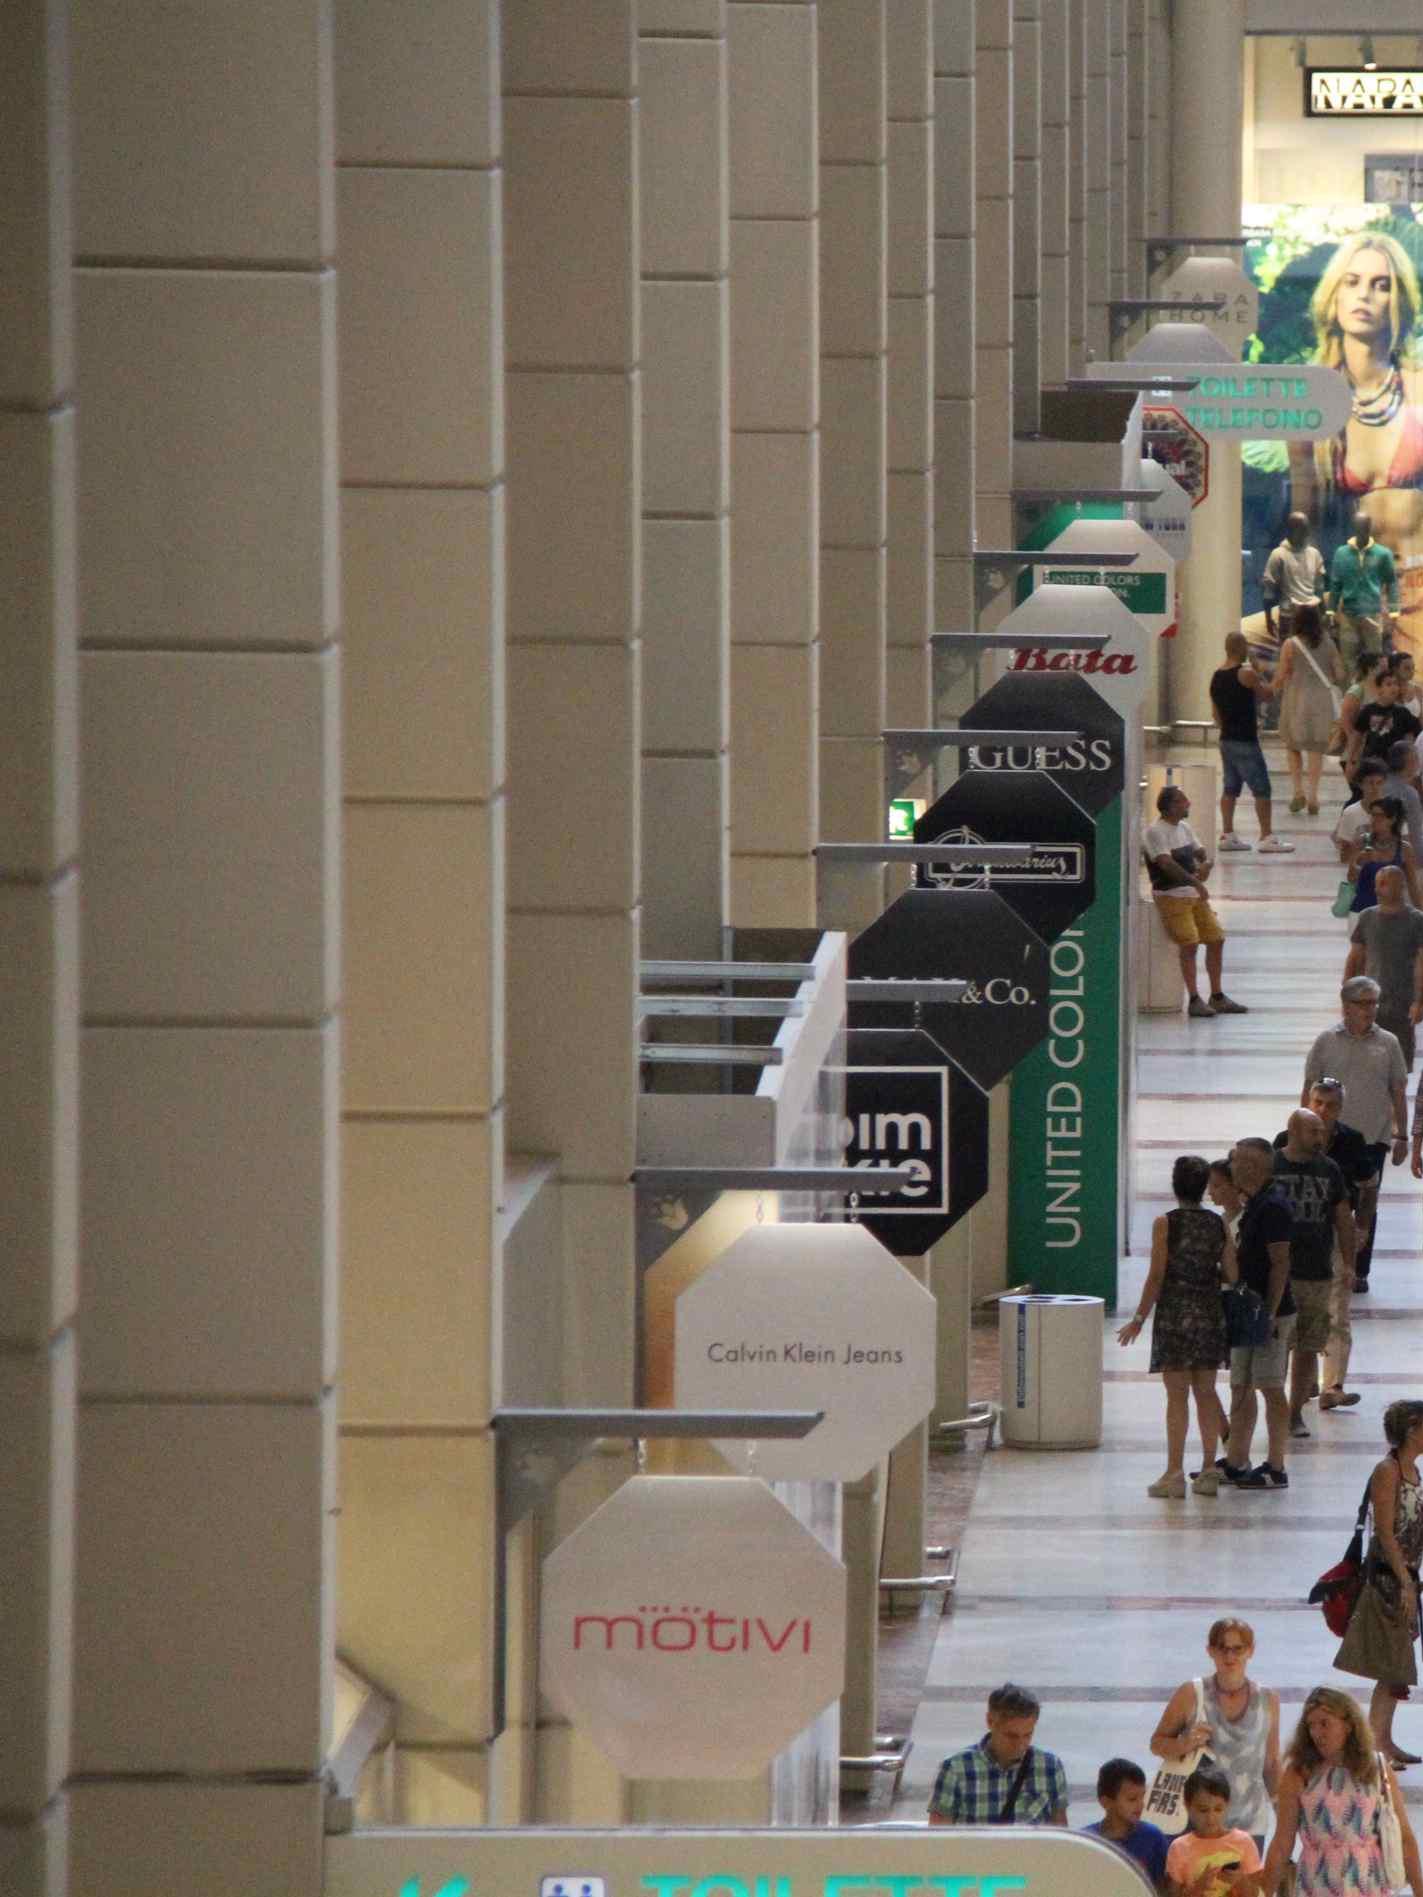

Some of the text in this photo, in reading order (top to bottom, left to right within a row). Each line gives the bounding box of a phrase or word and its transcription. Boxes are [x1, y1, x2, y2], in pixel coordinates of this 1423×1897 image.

[1186, 407, 1322, 430] TELEFONO
[1007, 648, 1137, 675] Bata
[974, 740, 1112, 771] GUESS
[1045, 1081, 1083, 1248] UNITED
[707, 1342, 905, 1365] Calvin Klein Jeans
